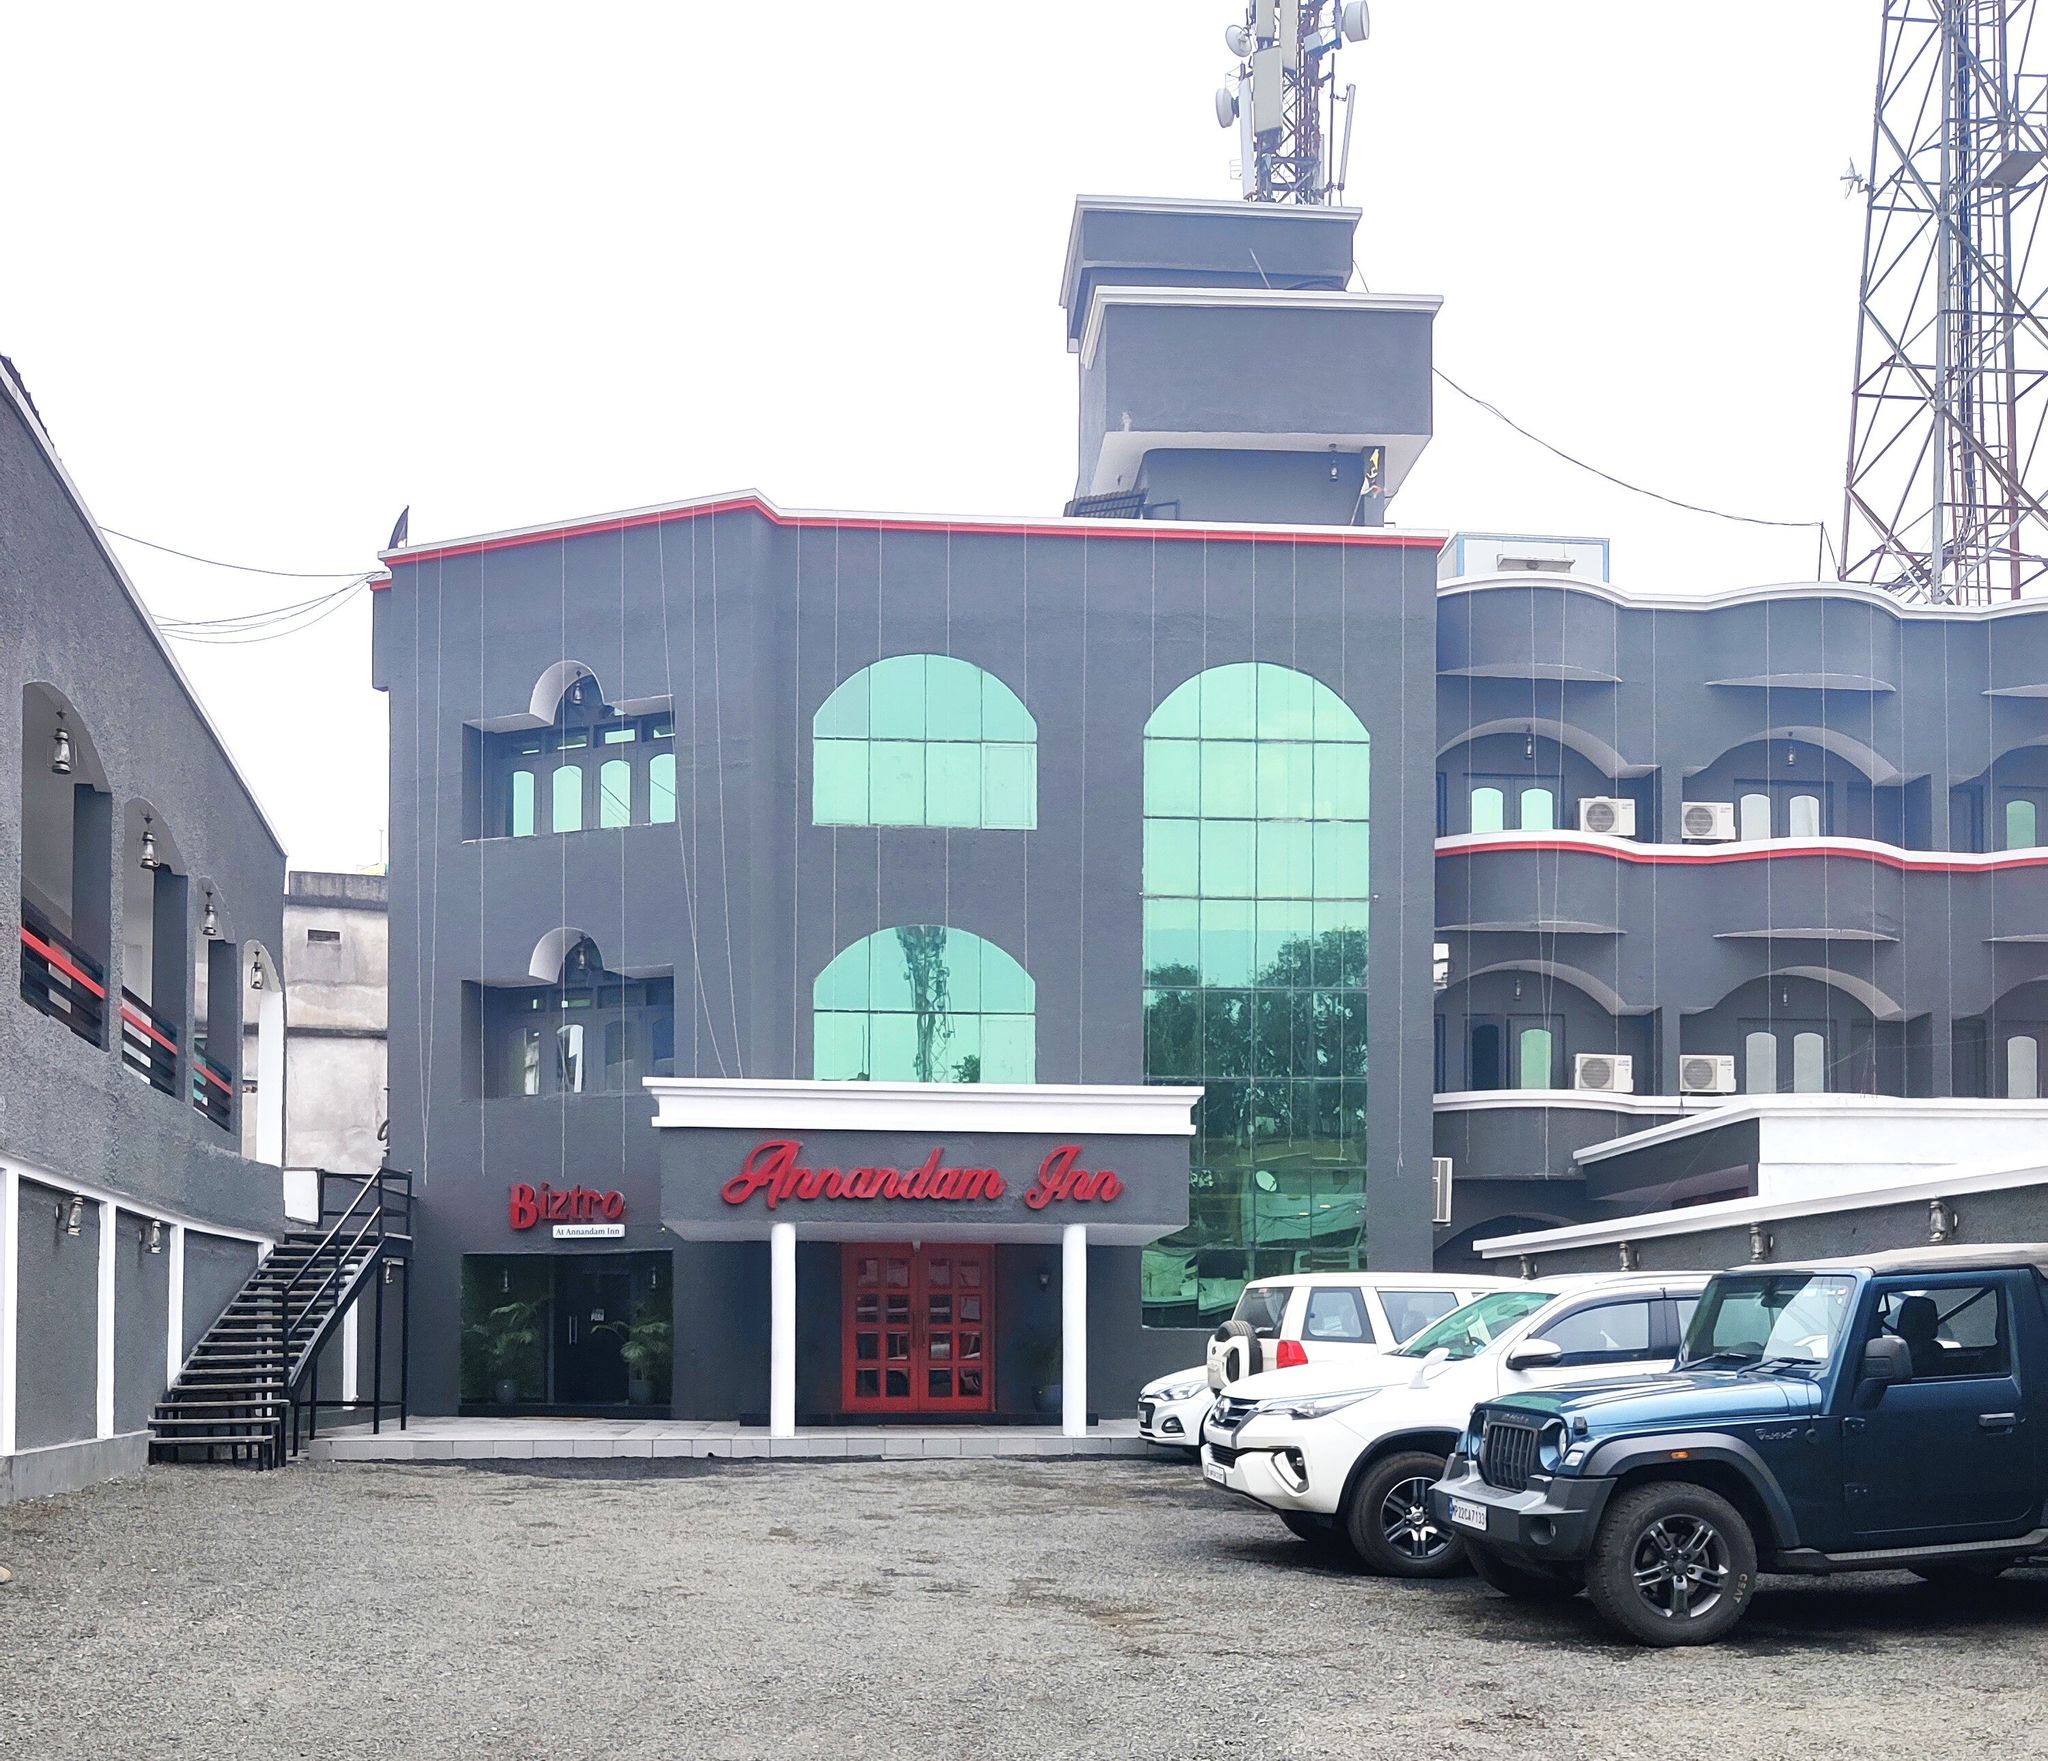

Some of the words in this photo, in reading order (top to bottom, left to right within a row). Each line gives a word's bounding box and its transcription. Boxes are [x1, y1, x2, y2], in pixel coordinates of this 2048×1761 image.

[722, 1139, 1008, 1209] Annandam
[1024, 1144, 1124, 1209] Inn
[510, 1183, 625, 1230] Biztro
[555, 1227, 564, 1236] At
[566, 1226, 605, 1236] Annandam
[607, 1226, 620, 1235] Inn
